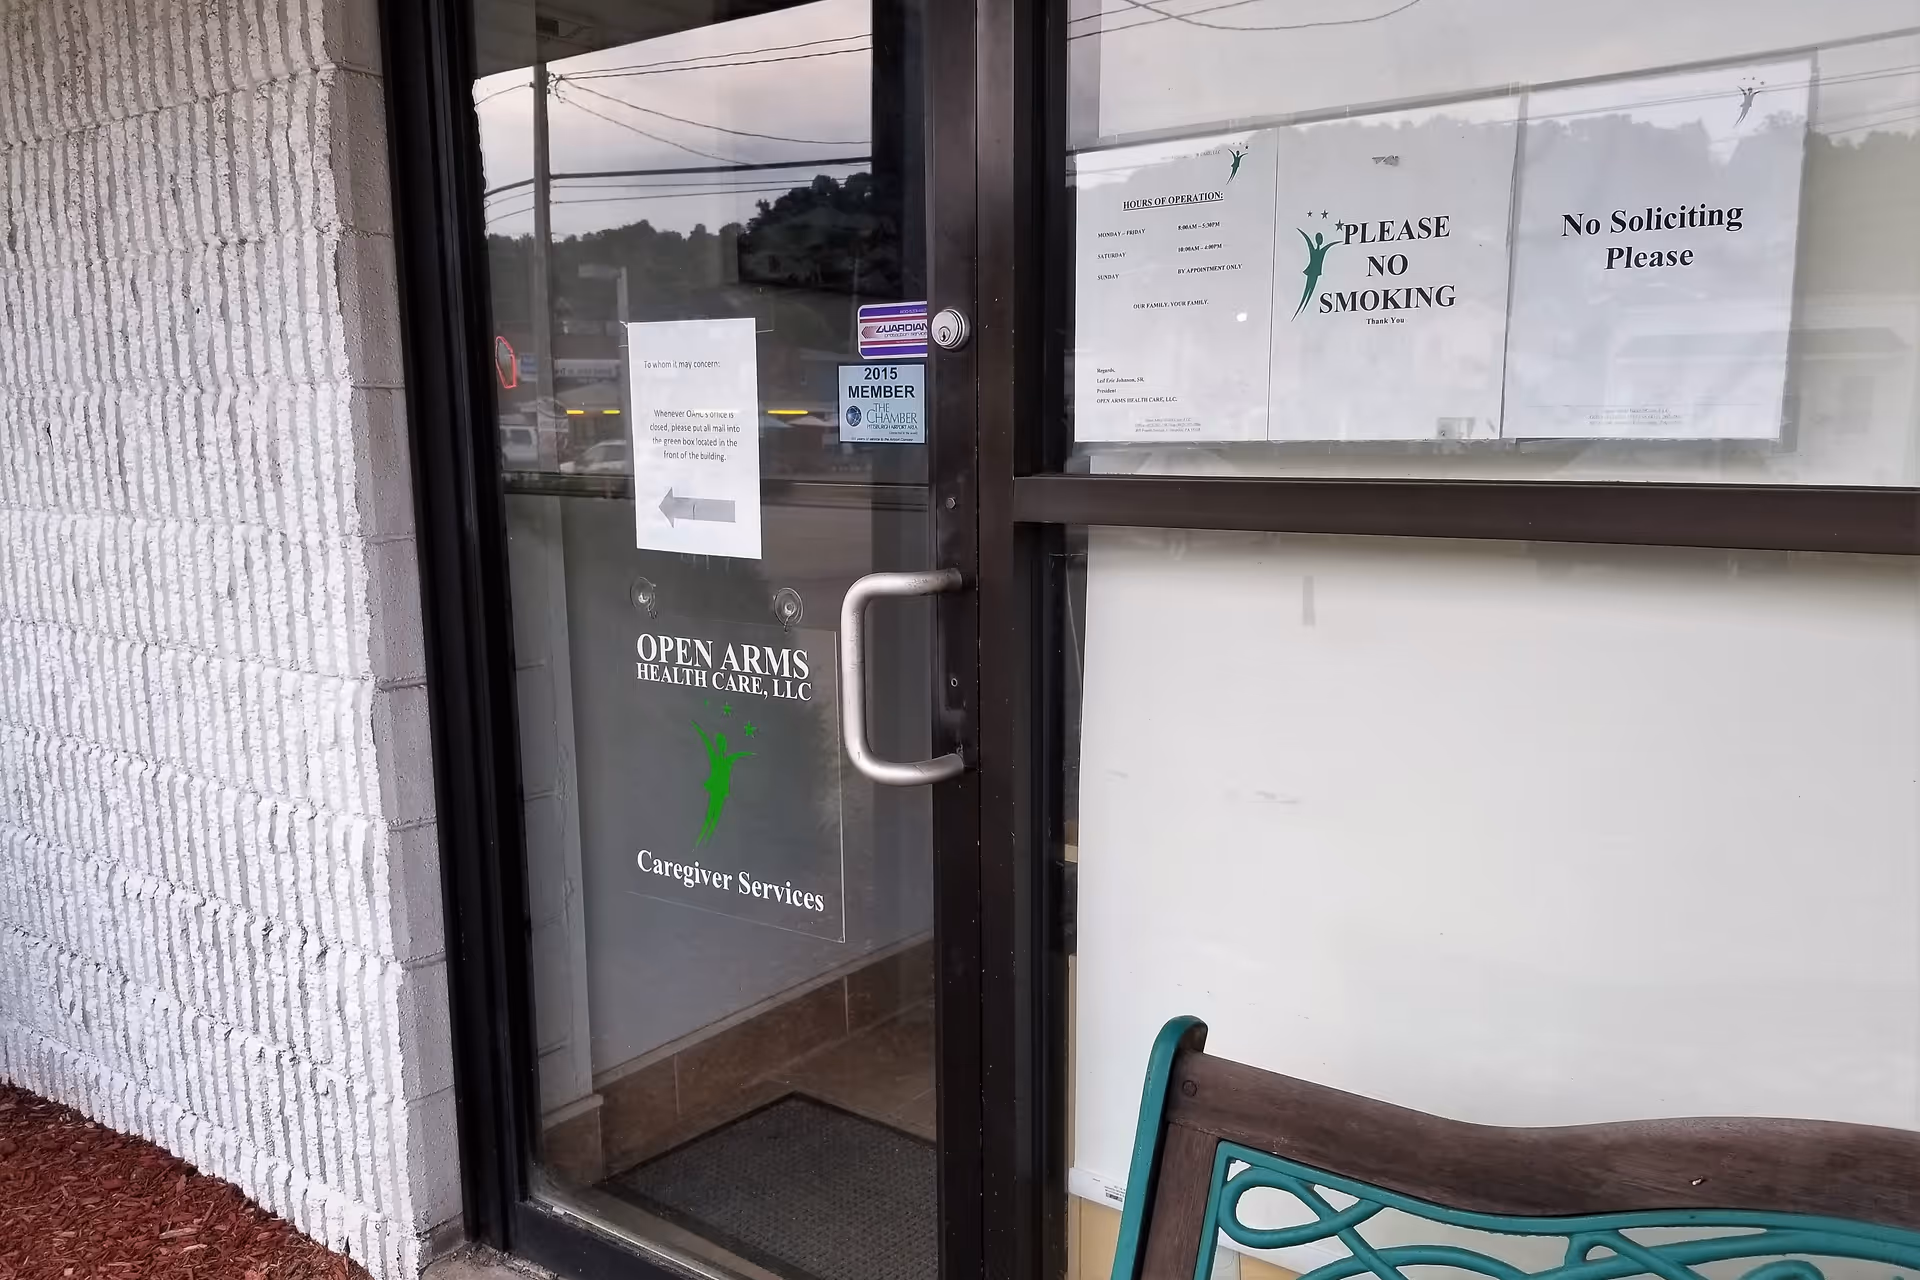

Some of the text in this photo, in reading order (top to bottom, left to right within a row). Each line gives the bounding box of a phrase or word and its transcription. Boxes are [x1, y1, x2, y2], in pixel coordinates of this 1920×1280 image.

[1123, 191, 1224, 210] HOURS OF OPERATION:
[1561, 203, 1744, 237] No Soliciting
[1126, 228, 1146, 236] FRIDAY
[1343, 216, 1451, 245] PLEASE
[1097, 251, 1127, 259] SATURDAY
[1604, 246, 1695, 270] Please
[1186, 265, 1226, 274] APPOINTMENT
[1226, 263, 1243, 271] ONLY
[1367, 253, 1409, 277] NO
[1097, 273, 1120, 281] SUNDAY
[1319, 284, 1456, 314] SMOKING
[1366, 316, 1405, 325] Thank You
[643, 360, 721, 371] To whom it may concern:
[863, 367, 898, 380] 2015
[848, 385, 915, 399] MEMBER
[653, 409, 685, 418] Whenever
[873, 402, 890, 413] THE
[866, 409, 918, 424] CHAMBER
[650, 422, 741, 433] closed, please put all mail into
[652, 436, 738, 447] the green box located in the
[663, 449, 727, 463] front of the building.
[636, 633, 810, 680] OPEN ARMS
[636, 662, 812, 702] HEALTH CARE, LLC
[637, 849, 825, 913] Caregiver Services
